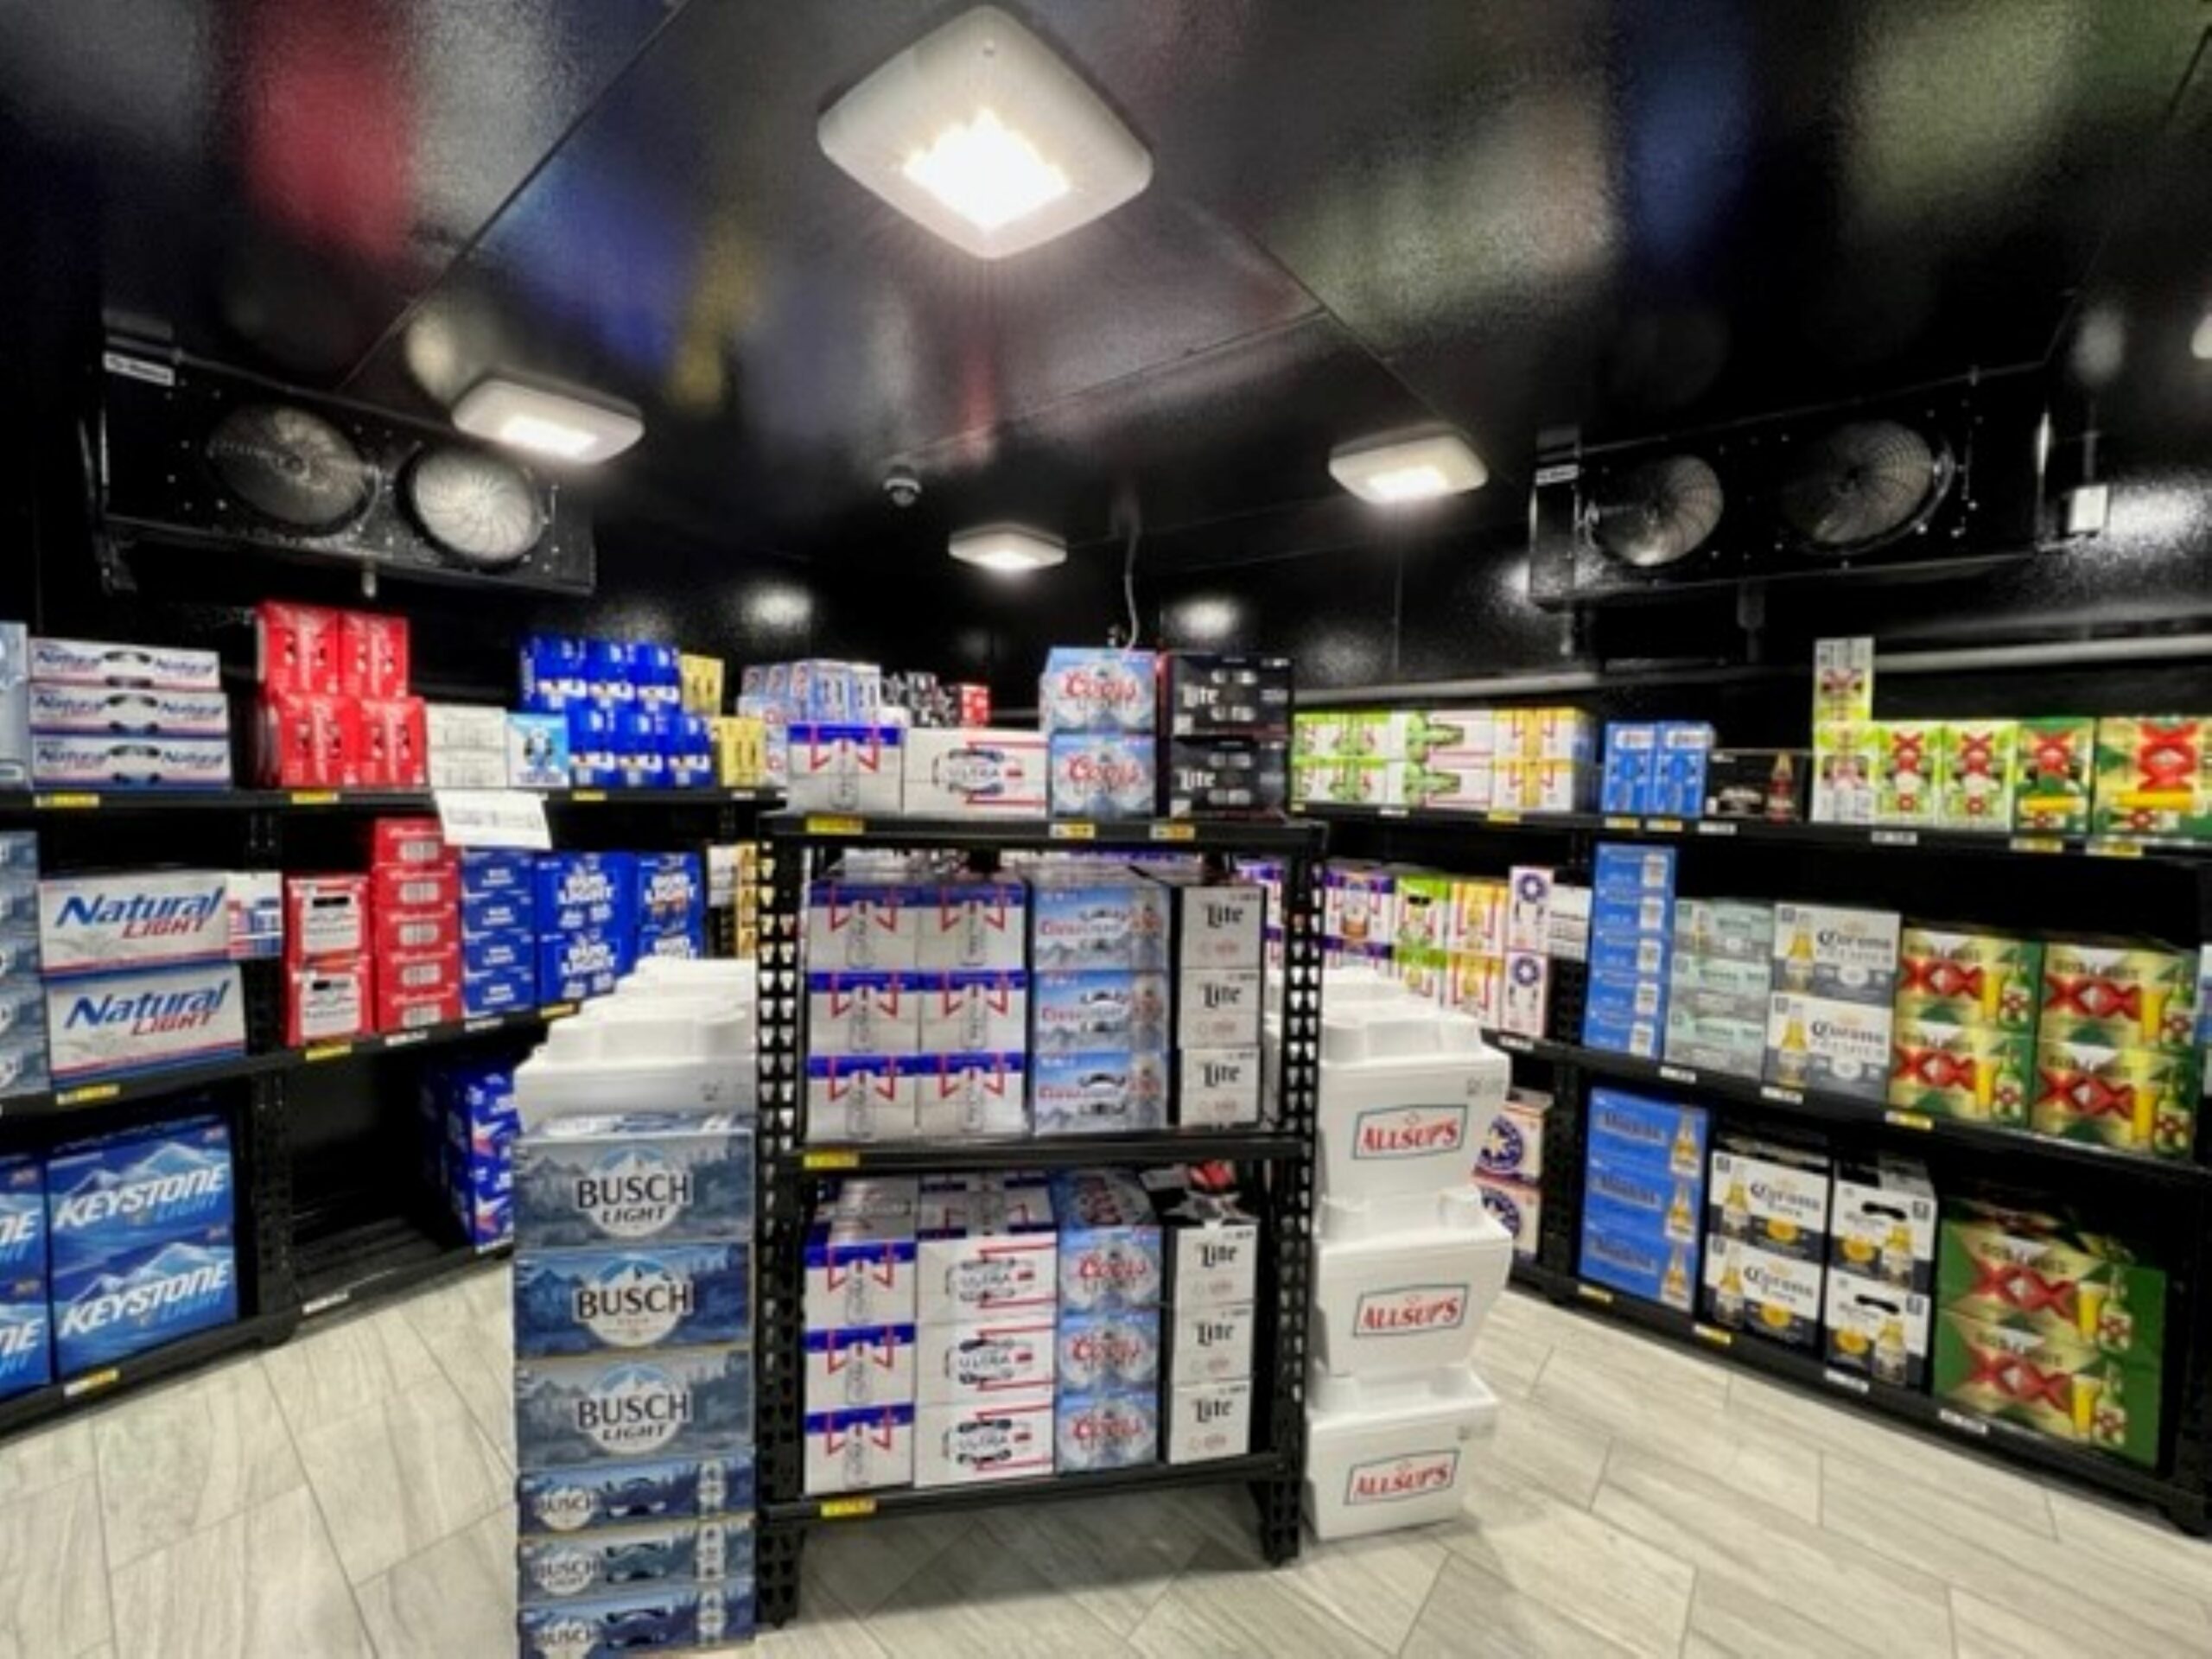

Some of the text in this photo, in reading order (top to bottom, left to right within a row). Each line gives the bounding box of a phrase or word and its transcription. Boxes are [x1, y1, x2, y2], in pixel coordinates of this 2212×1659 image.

[54, 887, 226, 928] Natural
[1203, 903, 1244, 929] Lite
[121, 917, 208, 940] LIGHT
[63, 981, 232, 1029] Natural
[1200, 983, 1242, 1009] Lite
[130, 1011, 213, 1037] LIGHT
[1199, 1064, 1241, 1089] Lite
[1363, 1120, 1458, 1151] ALLSUP'S
[52, 1161, 227, 1231] KEYSTONE
[576, 1173, 689, 1210] BUSCH
[156, 1192, 219, 1222] LIGHT
[601, 1205, 666, 1224] LIGHT
[1197, 1243, 1238, 1268] Lite
[58, 1257, 232, 1338] KEYSTONE
[576, 1284, 689, 1320] BUSCH
[1363, 1297, 1459, 1329] ALLSUP'S
[1193, 1321, 1235, 1347] Lite
[576, 1392, 690, 1428] BUSCH
[1192, 1398, 1234, 1424] Lite
[601, 1425, 665, 1441] LIGHT
[1354, 1464, 1448, 1496] ALLSUP'S
